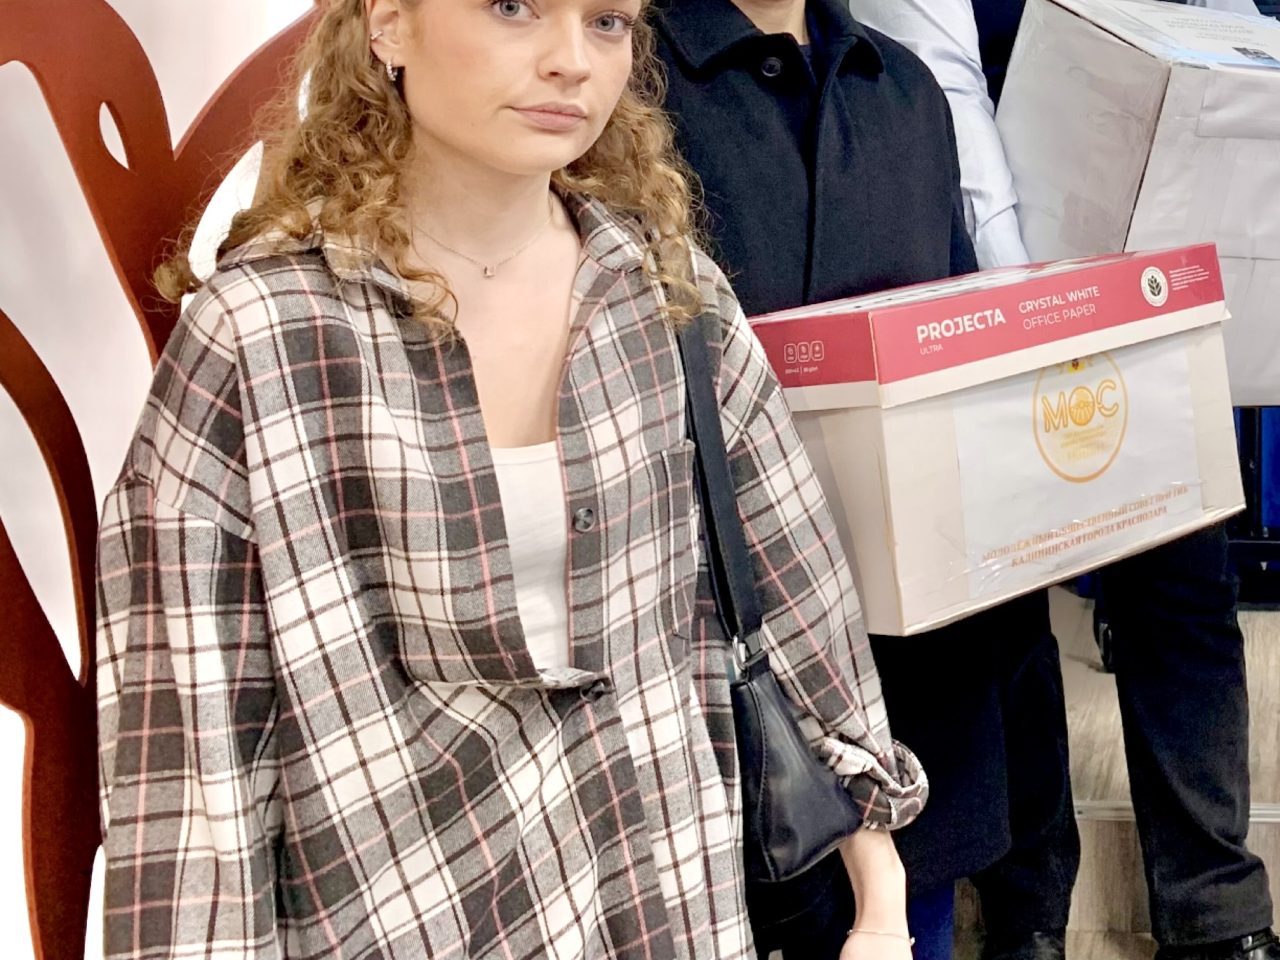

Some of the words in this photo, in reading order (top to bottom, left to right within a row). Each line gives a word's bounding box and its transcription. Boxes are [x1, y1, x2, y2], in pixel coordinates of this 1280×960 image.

[1018, 295, 1066, 315] CRYSTAL
[1066, 286, 1101, 303] WHITE
[916, 308, 1007, 344] PROJECTA
[1022, 312, 1062, 331] OFFICE
[1062, 303, 1097, 322] PAPER
[919, 343, 944, 356] ULTRA
